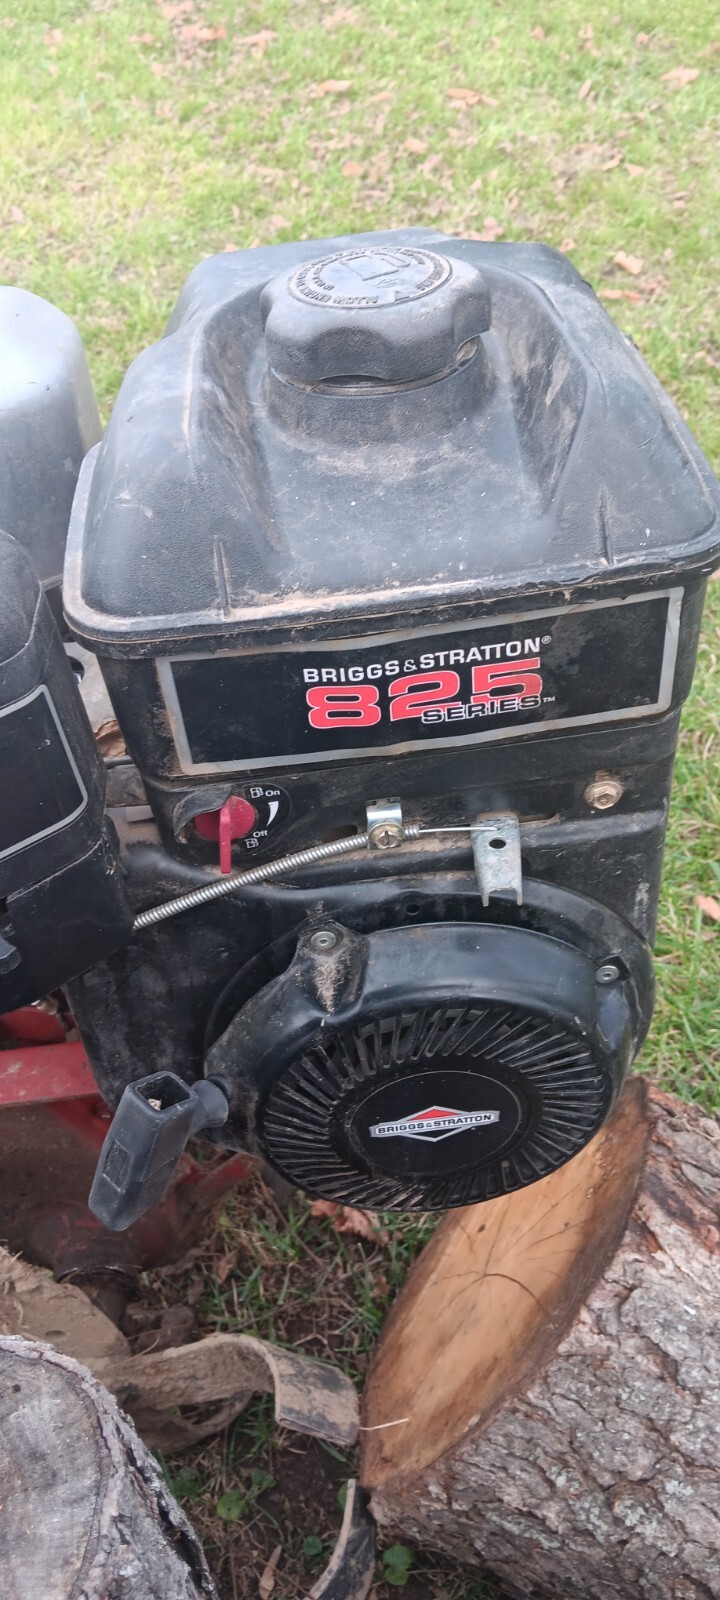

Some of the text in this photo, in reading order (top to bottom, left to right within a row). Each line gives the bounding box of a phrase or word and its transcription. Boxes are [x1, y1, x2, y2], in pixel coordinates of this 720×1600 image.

[306, 657, 543, 729] 825
[265, 789, 281, 797] On
[253, 829, 268, 838] Off
